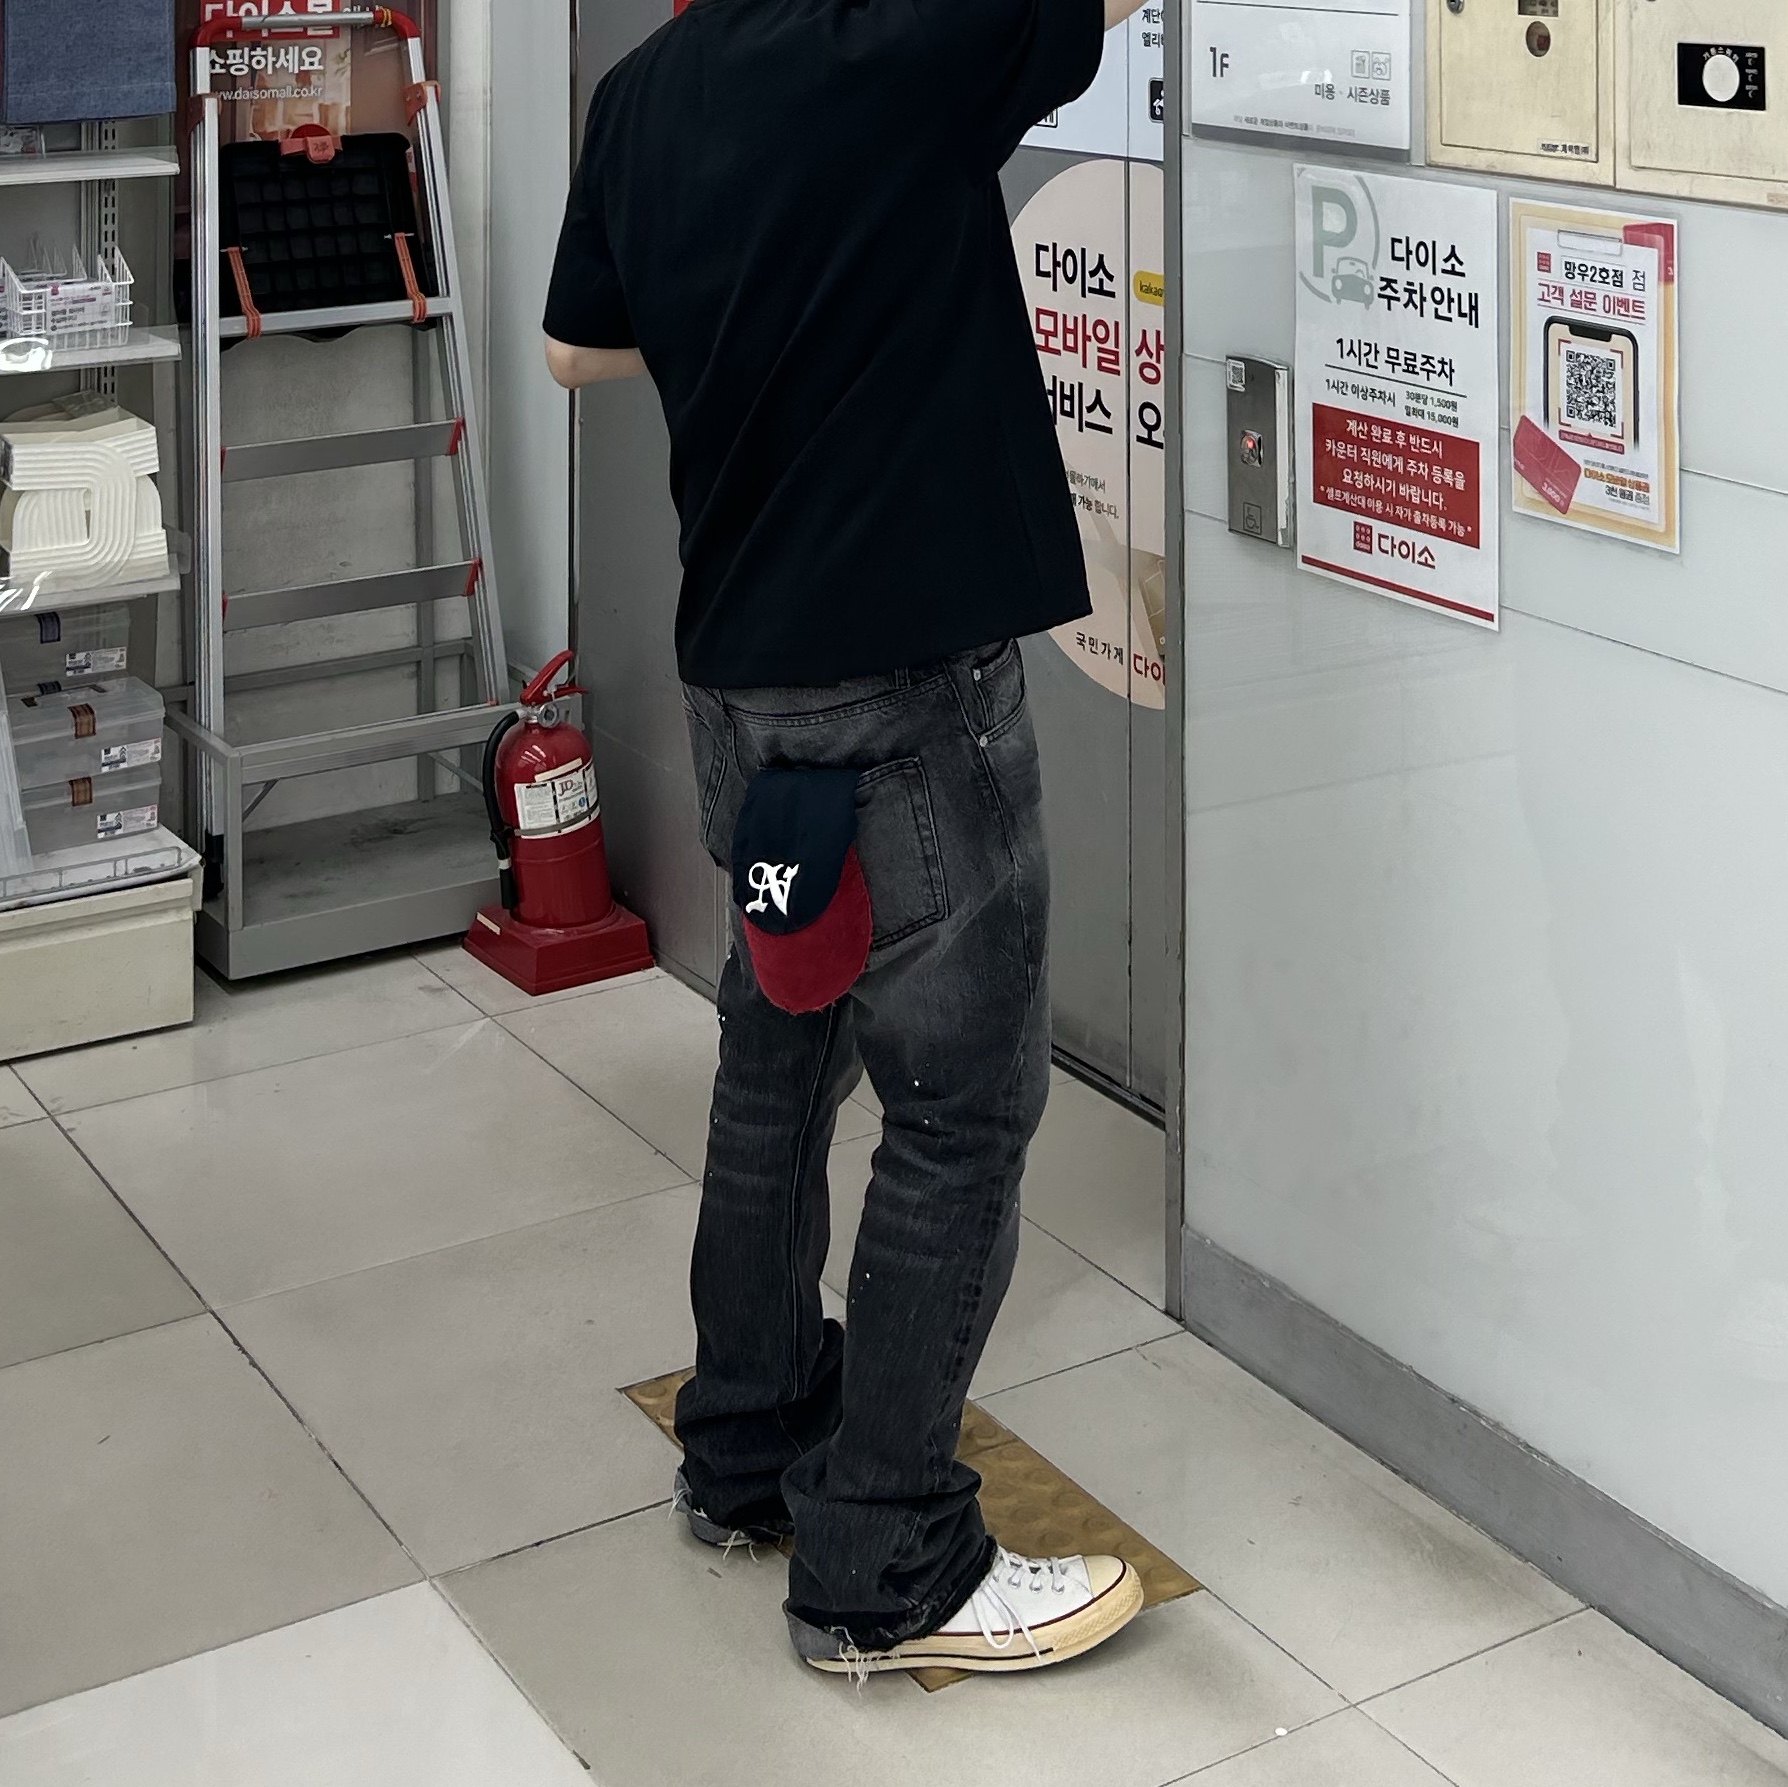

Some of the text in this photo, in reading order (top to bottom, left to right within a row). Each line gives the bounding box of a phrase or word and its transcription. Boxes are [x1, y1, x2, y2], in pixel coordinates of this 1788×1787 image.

[1142, 8, 1163, 24] 계단
[1142, 32, 1163, 48] 엘리
[1209, 46, 1229, 78] 1F
[1314, 83, 1390, 106] 미용 시즌상품
[1035, 241, 1116, 299] 다이소
[1391, 235, 1466, 278] 다이소
[1564, 260, 1624, 289] 망우2호점
[1632, 269, 1646, 292] 점
[1377, 276, 1479, 329] 주차안내
[1537, 282, 1646, 321] 고객 설문 이벤트
[1035, 306, 1121, 377] 모바일
[1134, 328, 1164, 386] 상
[1336, 337, 1456, 387] 1시간 무료주차
[1325, 378, 1349, 396] 1시간
[1351, 383, 1396, 408] 이상주차시
[1346, 419, 1443, 460] 계산 완료 후 반드시
[1065, 469, 1106, 494] 물하기에서
[1325, 438, 1466, 491] 카운터 직원에게 주차 등록을
[1078, 494, 1093, 511] 가능
[1342, 468, 1448, 511] 요청하시기 바랍니다.
[1377, 532, 1436, 570] 다이소
[1076, 631, 1124, 666] 국민가게
